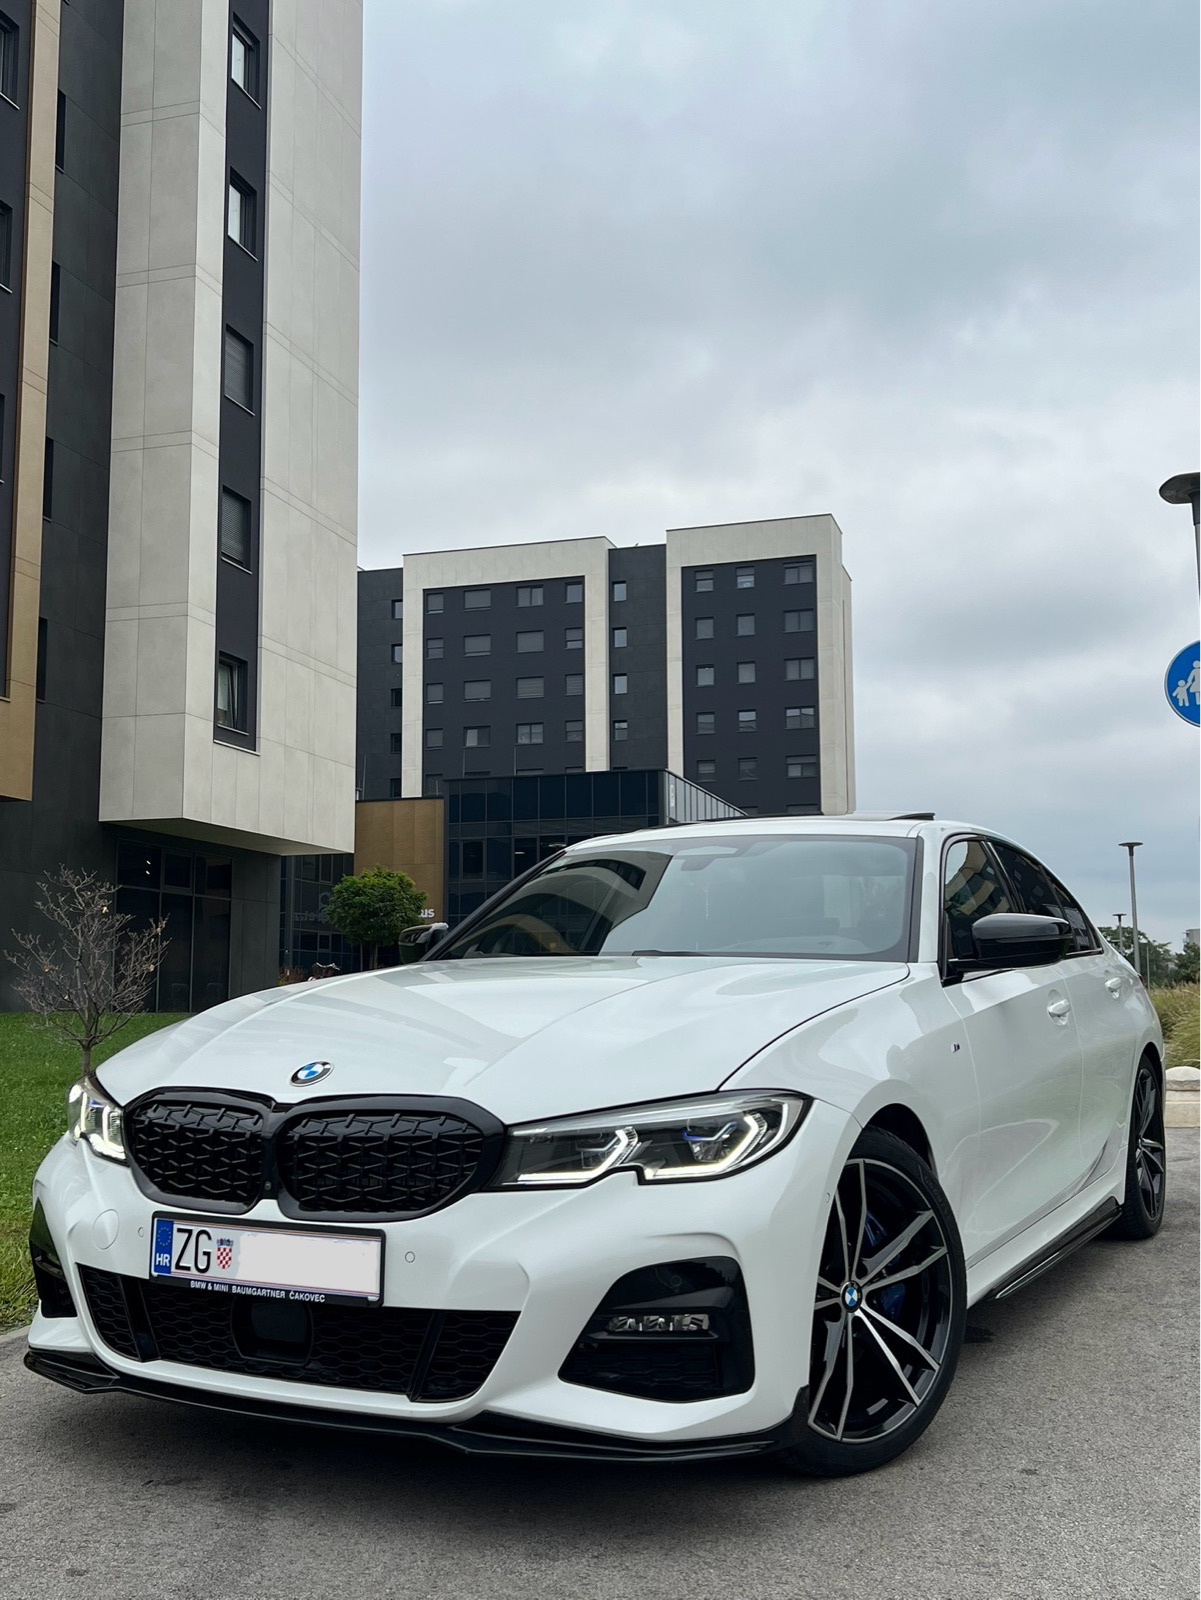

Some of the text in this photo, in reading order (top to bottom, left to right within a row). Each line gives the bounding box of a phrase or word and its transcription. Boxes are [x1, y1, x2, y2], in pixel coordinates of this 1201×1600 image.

[156, 1252, 171, 1267] HR
[175, 1227, 212, 1274] ZG
[190, 1280, 326, 1303] BMW & MINI BAUMGARTNER ČAKOVEC
